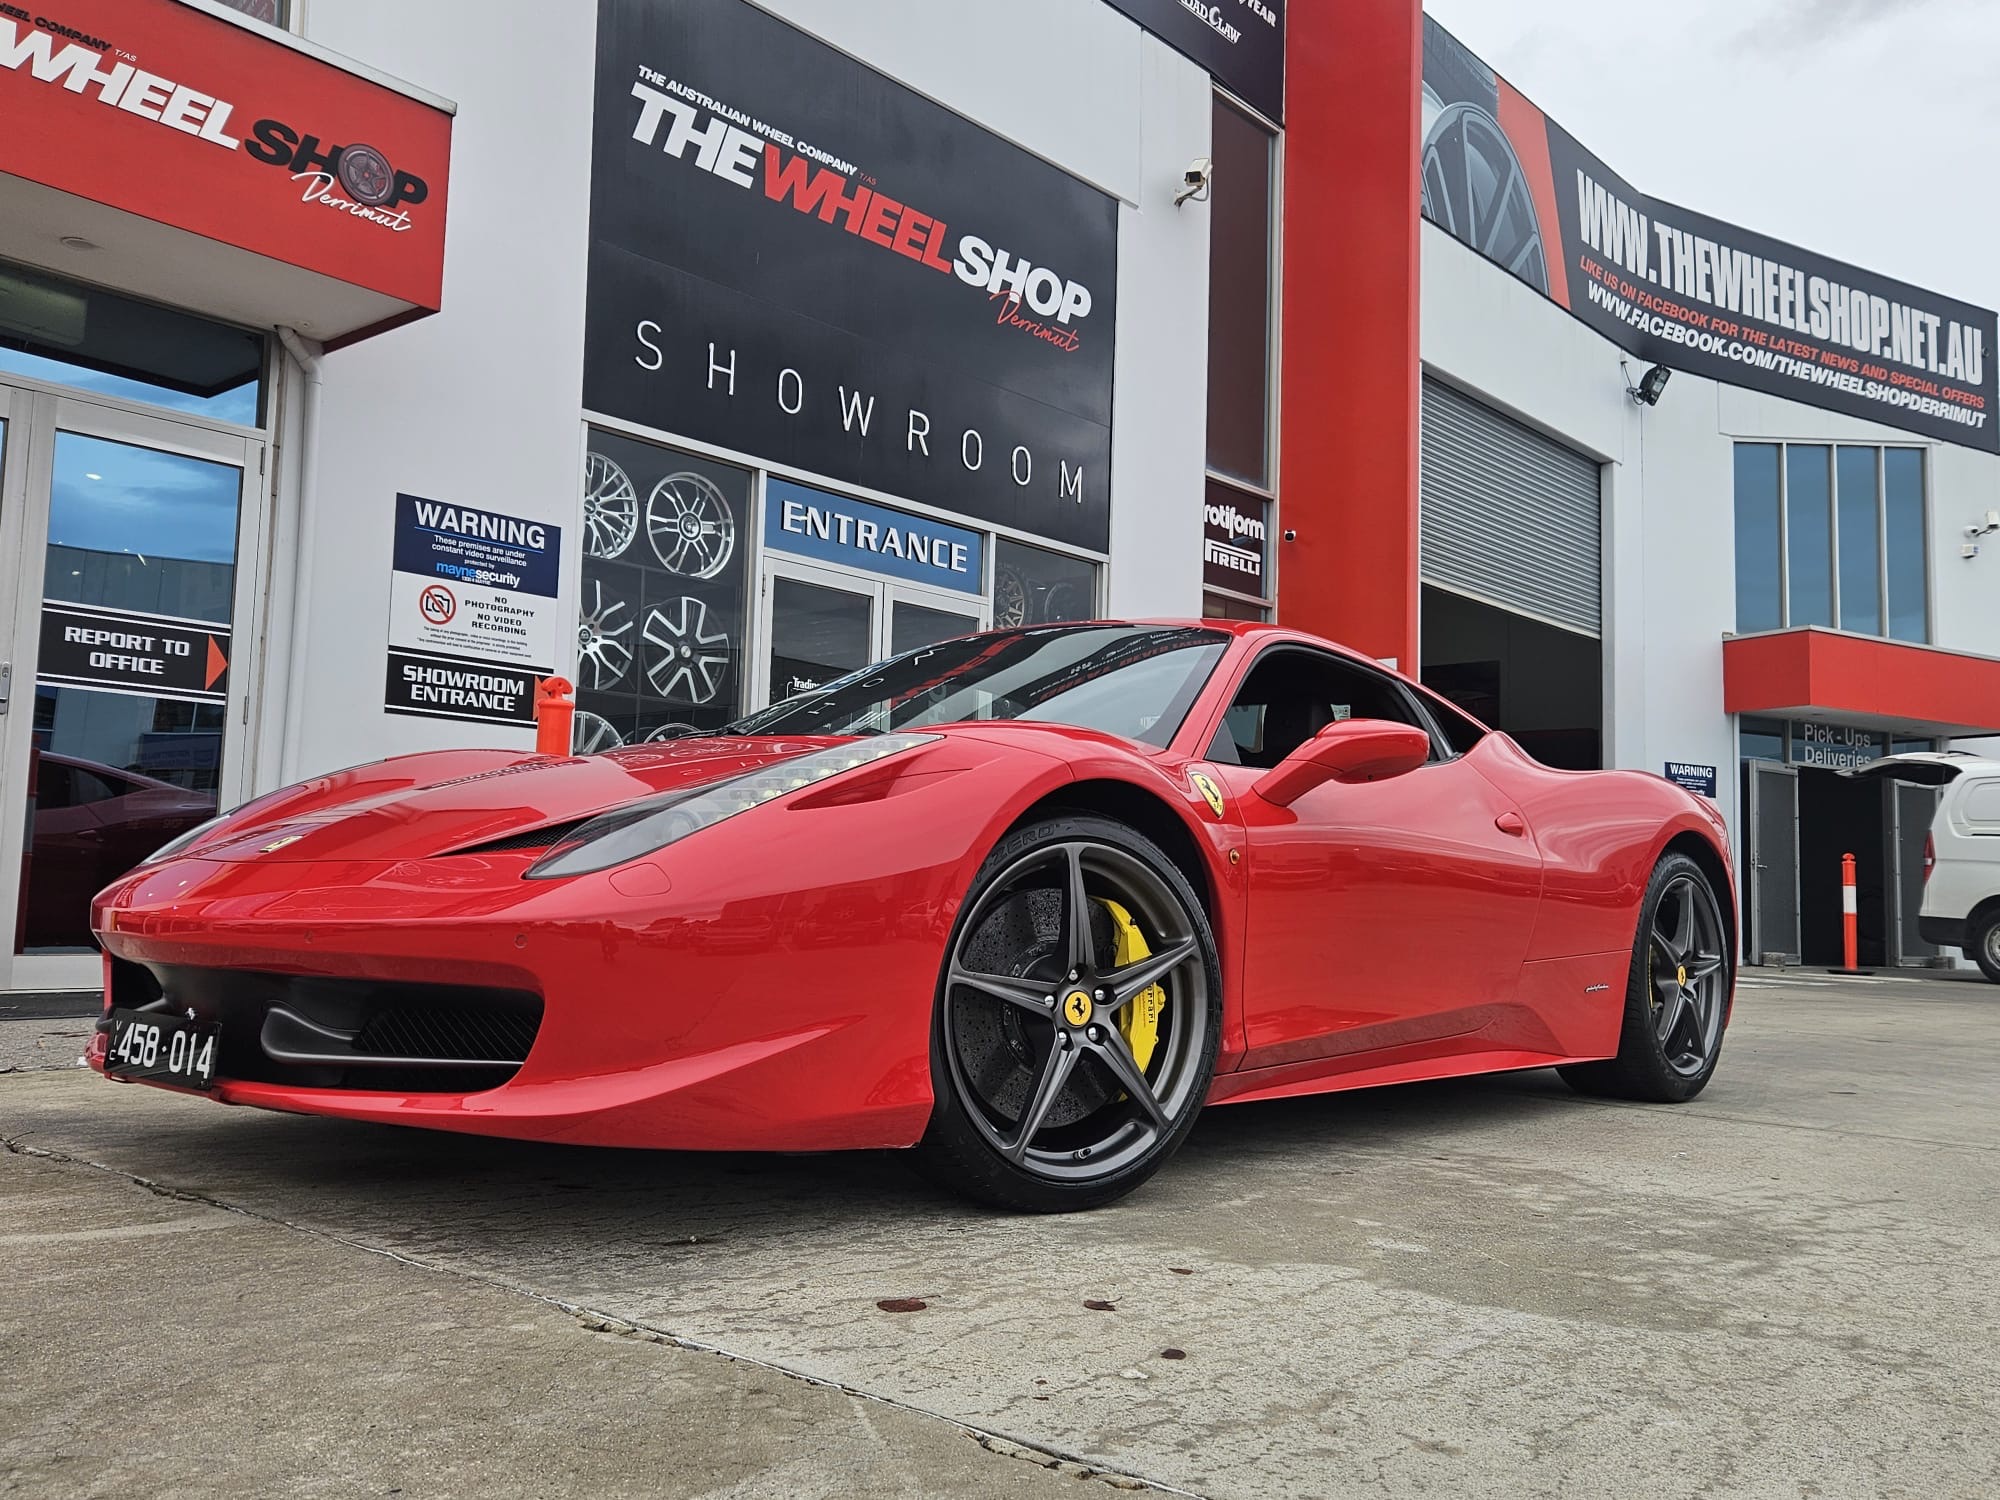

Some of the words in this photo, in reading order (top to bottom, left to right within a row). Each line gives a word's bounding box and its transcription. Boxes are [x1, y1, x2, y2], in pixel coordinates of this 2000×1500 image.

[34, 16, 112, 52] COMPANY
[114, 48, 137, 62] T/AS
[638, 64, 666, 87] THE
[666, 79, 750, 127] AUSTRALIAN
[752, 118, 795, 149] WHEEL
[797, 141, 858, 177] COMPANY
[291, 171, 411, 232] Derrimut
[953, 235, 1092, 325] SHOP
[989, 290, 1079, 352] Derrimut
[1579, 255, 1603, 279] LIKE
[1603, 271, 1618, 290] US
[1619, 281, 1636, 301] ON
[1637, 291, 1708, 329] FACEBOOK
[1711, 318, 1739, 338] FOR
[1741, 326, 1768, 346] THE
[1769, 335, 1820, 361] LATEST
[1820, 350, 1859, 373] NEWS
[1860, 363, 1888, 381] AND
[1889, 371, 1939, 397] SPECIAL
[1942, 386, 1985, 409] OFFERS
[1588, 279, 1987, 428] WWW.FACEBOOK.COM/THEWHEELSHOPDERRIMUT
[414, 500, 545, 549] WARNING
[781, 499, 968, 573] ENTRANCE
[432, 543, 463, 555] constant
[464, 549, 485, 559] video
[486, 553, 527, 567] surveillance
[434, 534, 457, 546] These
[458, 540, 491, 553] premises
[492, 547, 504, 555] are
[505, 549, 526, 559] under
[1204, 538, 1261, 576] PIRELLI
[464, 599, 535, 618] PHOTOGRAPHY
[494, 595, 508, 604] NO
[471, 620, 527, 636] RECORDING
[477, 613, 491, 621] NO
[494, 615, 522, 627] VIDEO
[64, 626, 156, 652] REPORT
[162, 638, 190, 657] TO
[89, 652, 165, 675] OFFICE
[403, 665, 525, 696] SHOWROOM
[410, 684, 515, 712] ENTRANCE
[1804, 723, 1834, 744] Pick
[1845, 728, 1871, 751] Ups
[1670, 763, 1713, 778] WARNING
[1804, 745, 1871, 769] Deliveries
